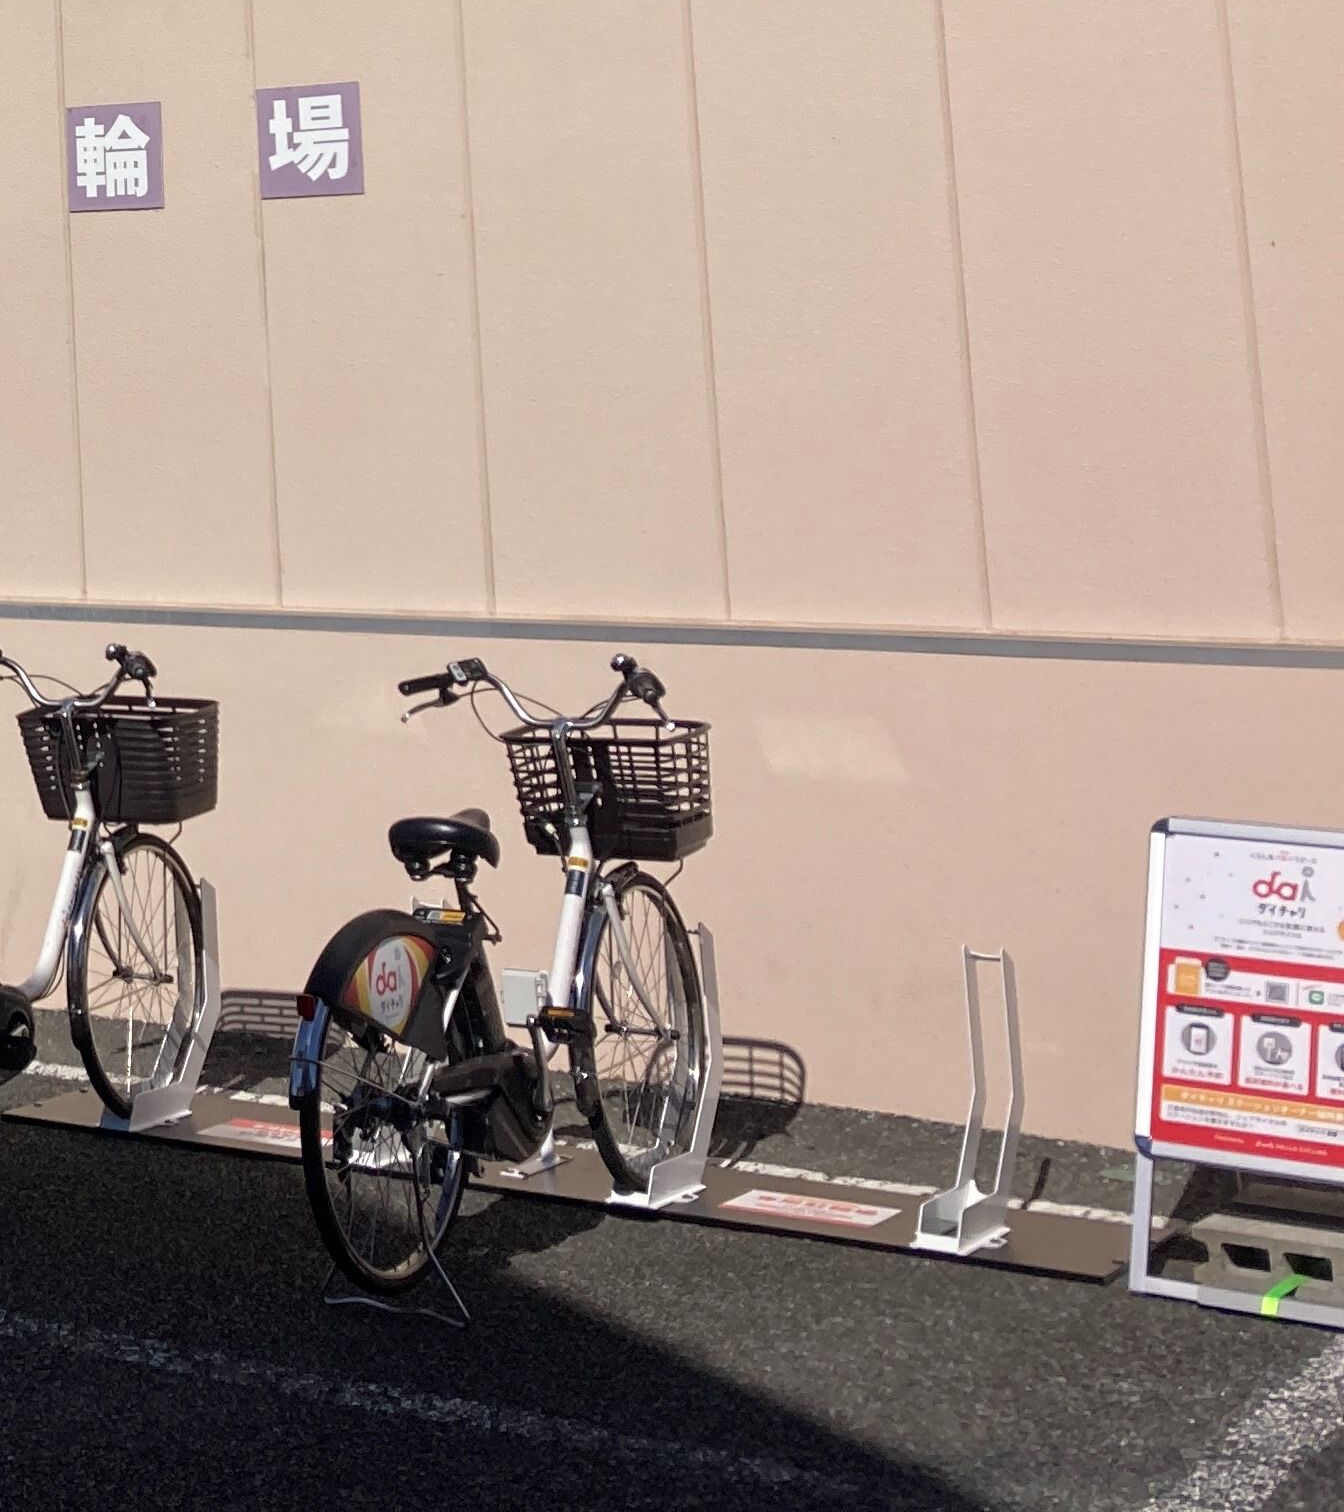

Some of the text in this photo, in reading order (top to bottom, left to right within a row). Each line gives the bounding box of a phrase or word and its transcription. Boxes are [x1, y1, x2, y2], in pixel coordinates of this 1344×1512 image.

[1258, 903, 1307, 919] ダイチャリ
